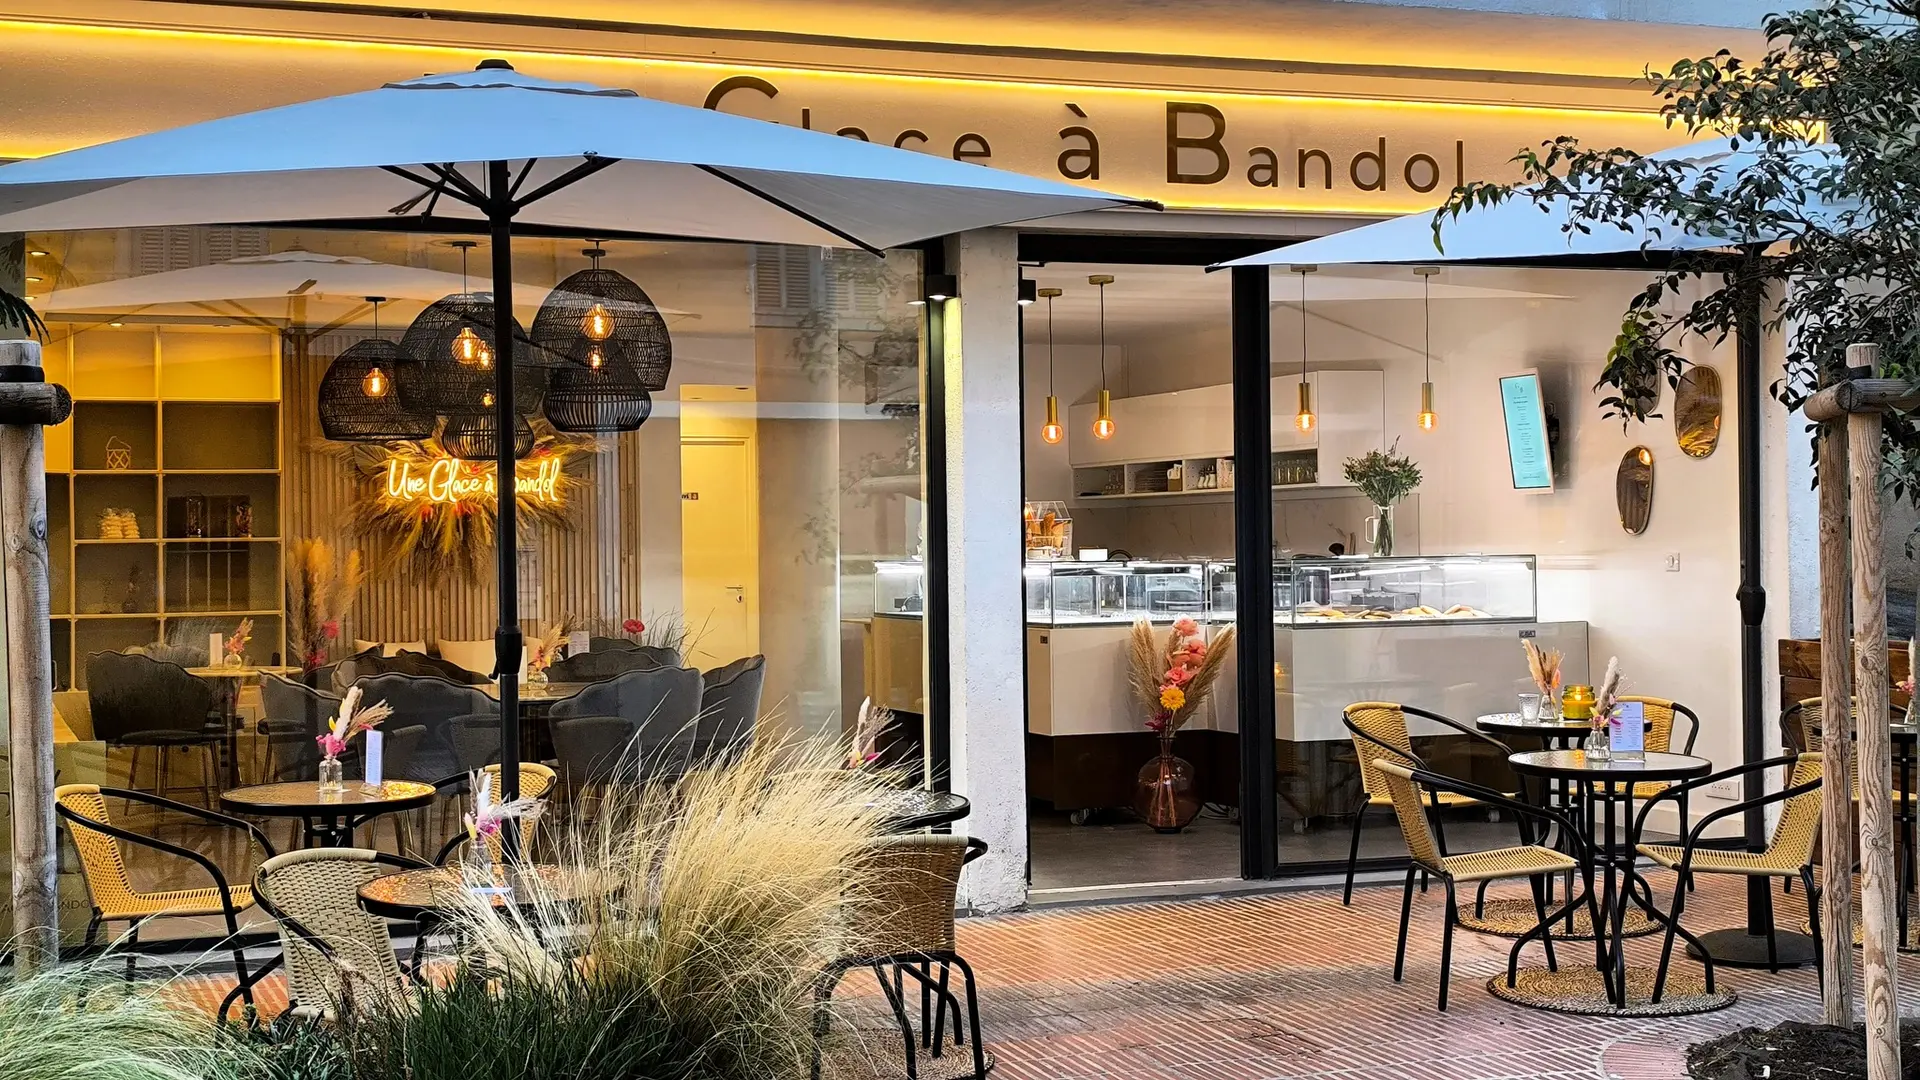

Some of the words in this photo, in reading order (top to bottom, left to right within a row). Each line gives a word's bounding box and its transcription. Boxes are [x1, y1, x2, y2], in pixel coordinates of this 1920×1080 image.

[1057, 103, 1100, 181] à
[1165, 101, 1464, 194] Bandol
[389, 458, 426, 500] Une
[428, 457, 483, 503] Glace
[484, 473, 495, 494] à
